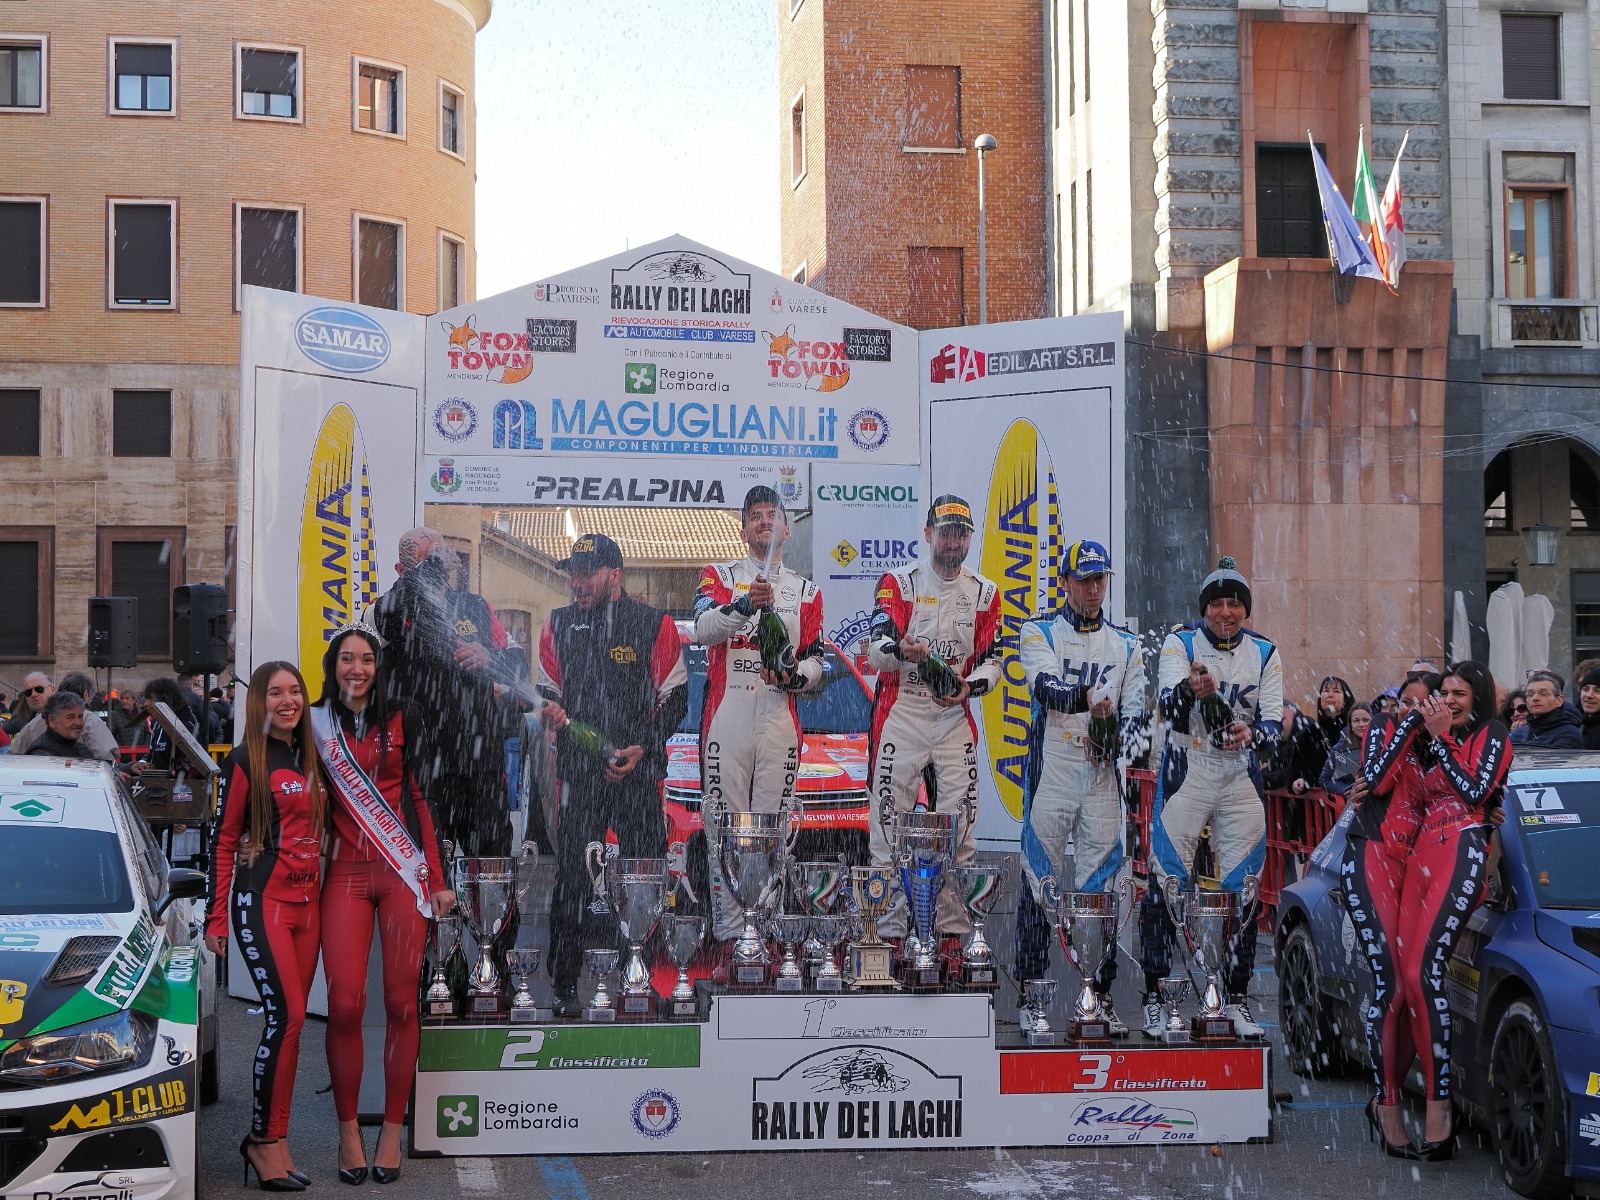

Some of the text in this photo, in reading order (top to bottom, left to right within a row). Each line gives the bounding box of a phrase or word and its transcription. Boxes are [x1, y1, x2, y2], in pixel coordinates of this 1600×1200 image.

[560, 294, 600, 304] VARESE
[611, 284, 751, 314] RALLY DEI LAGHI
[789, 305, 828, 314] VARESE
[533, 325, 571, 336] FACTORY
[611, 316, 751, 329] RIEVOCAZIONE STORICA RALLY
[301, 323, 383, 353] SAMAR
[479, 331, 531, 351] FOX
[533, 337, 571, 347] STORES
[630, 327, 685, 339] AUTOMOBILE
[691, 330, 714, 340] CLUB
[720, 331, 754, 341] VARESE
[850, 333, 887, 345] FACTORY
[624, 349, 637, 357] Con
[644, 349, 678, 358] Patrocinio
[690, 351, 724, 360] Contributo
[725, 352, 732, 360] di
[798, 341, 848, 360] FOX
[849, 345, 886, 356] STORES
[989, 346, 1114, 372] EDIL ART S.R.L.
[448, 351, 532, 370] TOWN
[768, 360, 849, 378] TOWN
[660, 369, 714, 382] Regione
[660, 381, 730, 392] Lombardia
[551, 399, 838, 442] MAGUGLIANI.it
[570, 439, 813, 456] COMPONENTI PER L'INDUSTRIA
[534, 476, 725, 503] PREALPINA
[817, 484, 919, 502] CRUGNOL
[316, 480, 353, 641] MANIA
[352, 533, 361, 610] RVICE
[996, 492, 1038, 790] AUTOMANIA
[1523, 789, 1547, 808] 7
[335, 759, 364, 791] RALLY
[356, 788, 374, 808] DEI
[369, 804, 398, 835] LAGHI
[390, 830, 416, 859] 2025
[836, 813, 865, 821] VARESE
[1455, 846, 1484, 911] MISS
[1342, 860, 1367, 922] MISS
[237, 892, 260, 961] MISS
[1429, 915, 1459, 991] RALLY
[1361, 928, 1385, 1000] RALLY
[253, 967, 278, 1040] RALLY
[1434, 997, 1451, 1041] DEI
[830, 1026, 928, 1038] Classificato
[254, 1045, 271, 1091] DEI
[549, 1056, 649, 1068] Classificato
[1113, 1078, 1207, 1090] Classificato
[484, 1101, 558, 1116] Regione
[1074, 1103, 1168, 1128] Rally
[484, 1115, 579, 1130] Lombardia
[751, 1099, 962, 1140] RALLY DEI LAGHI
[1067, 1131, 1194, 1143] Coppa di Zona
[118, 1176, 135, 1185] SRL
